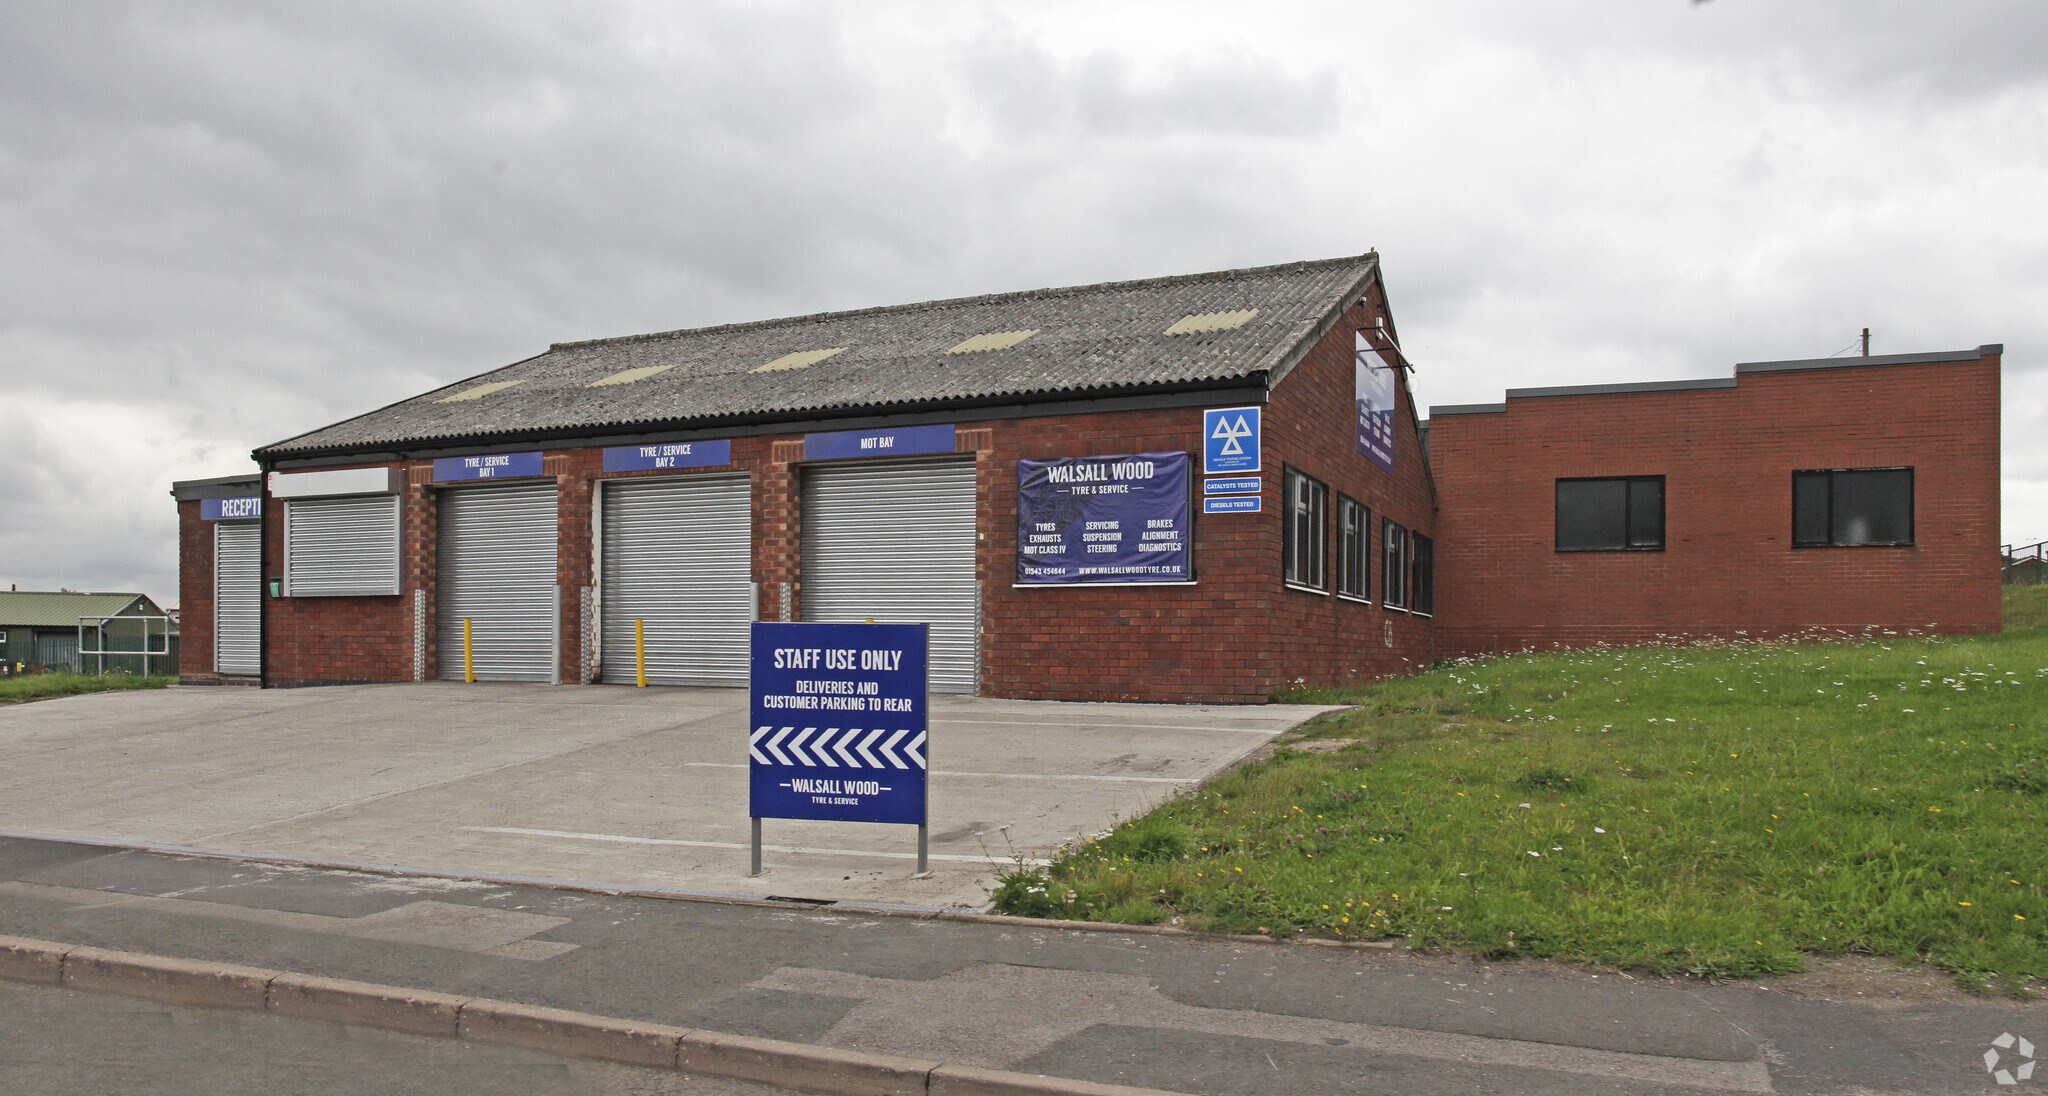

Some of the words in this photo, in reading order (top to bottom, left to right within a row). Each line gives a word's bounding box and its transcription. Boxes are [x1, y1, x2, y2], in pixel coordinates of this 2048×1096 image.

[860, 437, 877, 449] MOT
[879, 436, 894, 449] BAY
[640, 446, 657, 457] TYRE
[657, 445, 662, 456] /
[663, 444, 691, 456] SERVICE
[465, 457, 480, 468] TYRE
[480, 456, 485, 467] /
[485, 455, 509, 467] SERVICE
[655, 456, 669, 468] BAY
[669, 456, 674, 467] 2
[479, 467, 491, 478] BAY
[491, 467, 495, 477] 1
[1047, 463, 1108, 483] WALSALL
[1111, 461, 1154, 481] WOOD
[1071, 486, 1090, 495] TYRE
[1091, 485, 1097, 494] &
[1098, 484, 1129, 494] SERVICE
[1036, 522, 1056, 532] TYRES
[1085, 521, 1119, 530] SERVICING
[1147, 519, 1174, 529] BRAKES
[1029, 534, 1062, 544] EXHAUSTS
[1082, 532, 1122, 542] SUSPENSION
[1141, 531, 1179, 541] ALIGNMENT
[1024, 545, 1039, 555] MOT
[1038, 545, 1059, 554] CLASS
[1059, 545, 1066, 554] IV
[1086, 544, 1118, 553] STEERING
[1138, 542, 1182, 553] DIAGNOSTICS
[1024, 567, 1043, 575] 01543
[1078, 565, 1181, 575] WWW.WALSALLWOODTYRE.CO.UK
[774, 648, 821, 669] STAFF
[825, 649, 857, 670] USE
[861, 650, 902, 671] ONLY
[796, 680, 854, 695] DELIVERIES
[856, 681, 879, 695] AND
[764, 695, 819, 710] CUSTOMER
[820, 696, 865, 711] PARKING
[868, 698, 881, 711] TO
[884, 698, 912, 712] REAR
[792, 778, 842, 794] WALSALL
[844, 780, 879, 796] WOOD
[811, 796, 827, 804] TYRE
[828, 797, 833, 805] &
[834, 797, 859, 806] SERVICE
